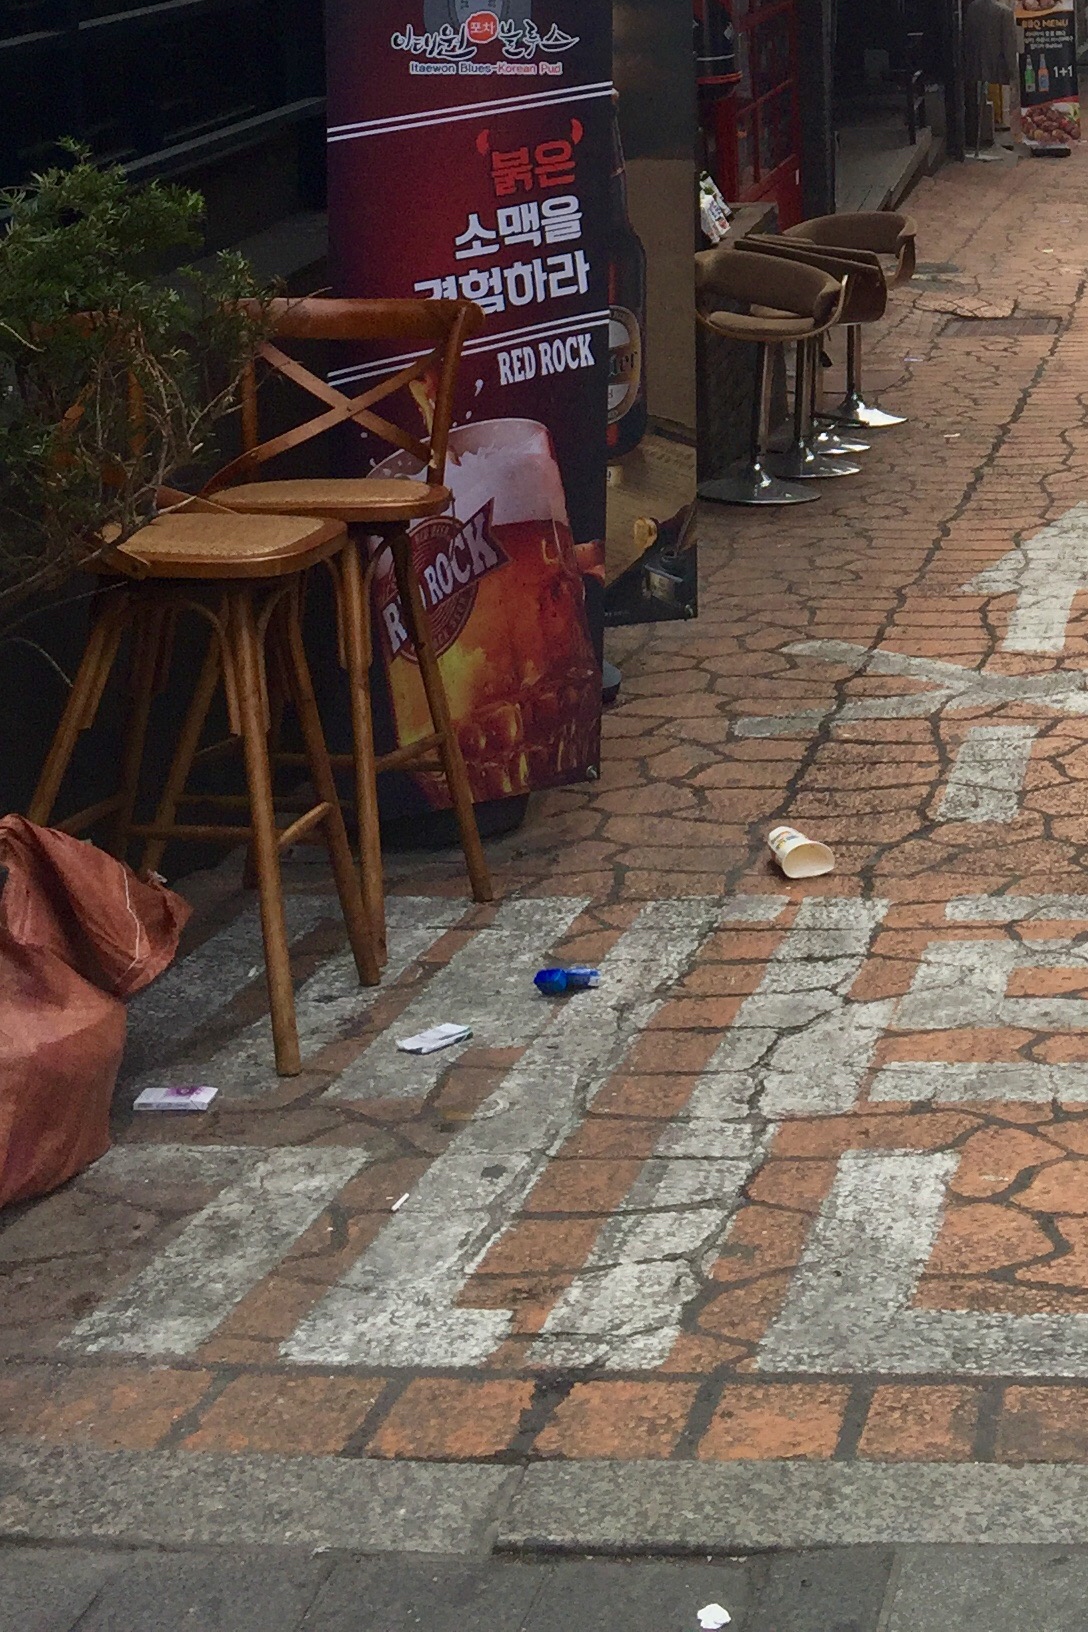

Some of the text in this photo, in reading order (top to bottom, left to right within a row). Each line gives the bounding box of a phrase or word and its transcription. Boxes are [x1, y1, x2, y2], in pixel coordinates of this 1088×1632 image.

[391, 18, 580, 60] 이태원 블루스
[470, 21, 496, 34] 포차
[410, 61, 457, 75] Itaewon
[1053, 64, 1074, 78] 1+1
[491, 139, 577, 196] 붉은
[455, 195, 583, 260] 소맥을
[497, 346, 537, 386] RED
[538, 333, 596, 377] ROCK
[423, 511, 498, 606] ROCK
